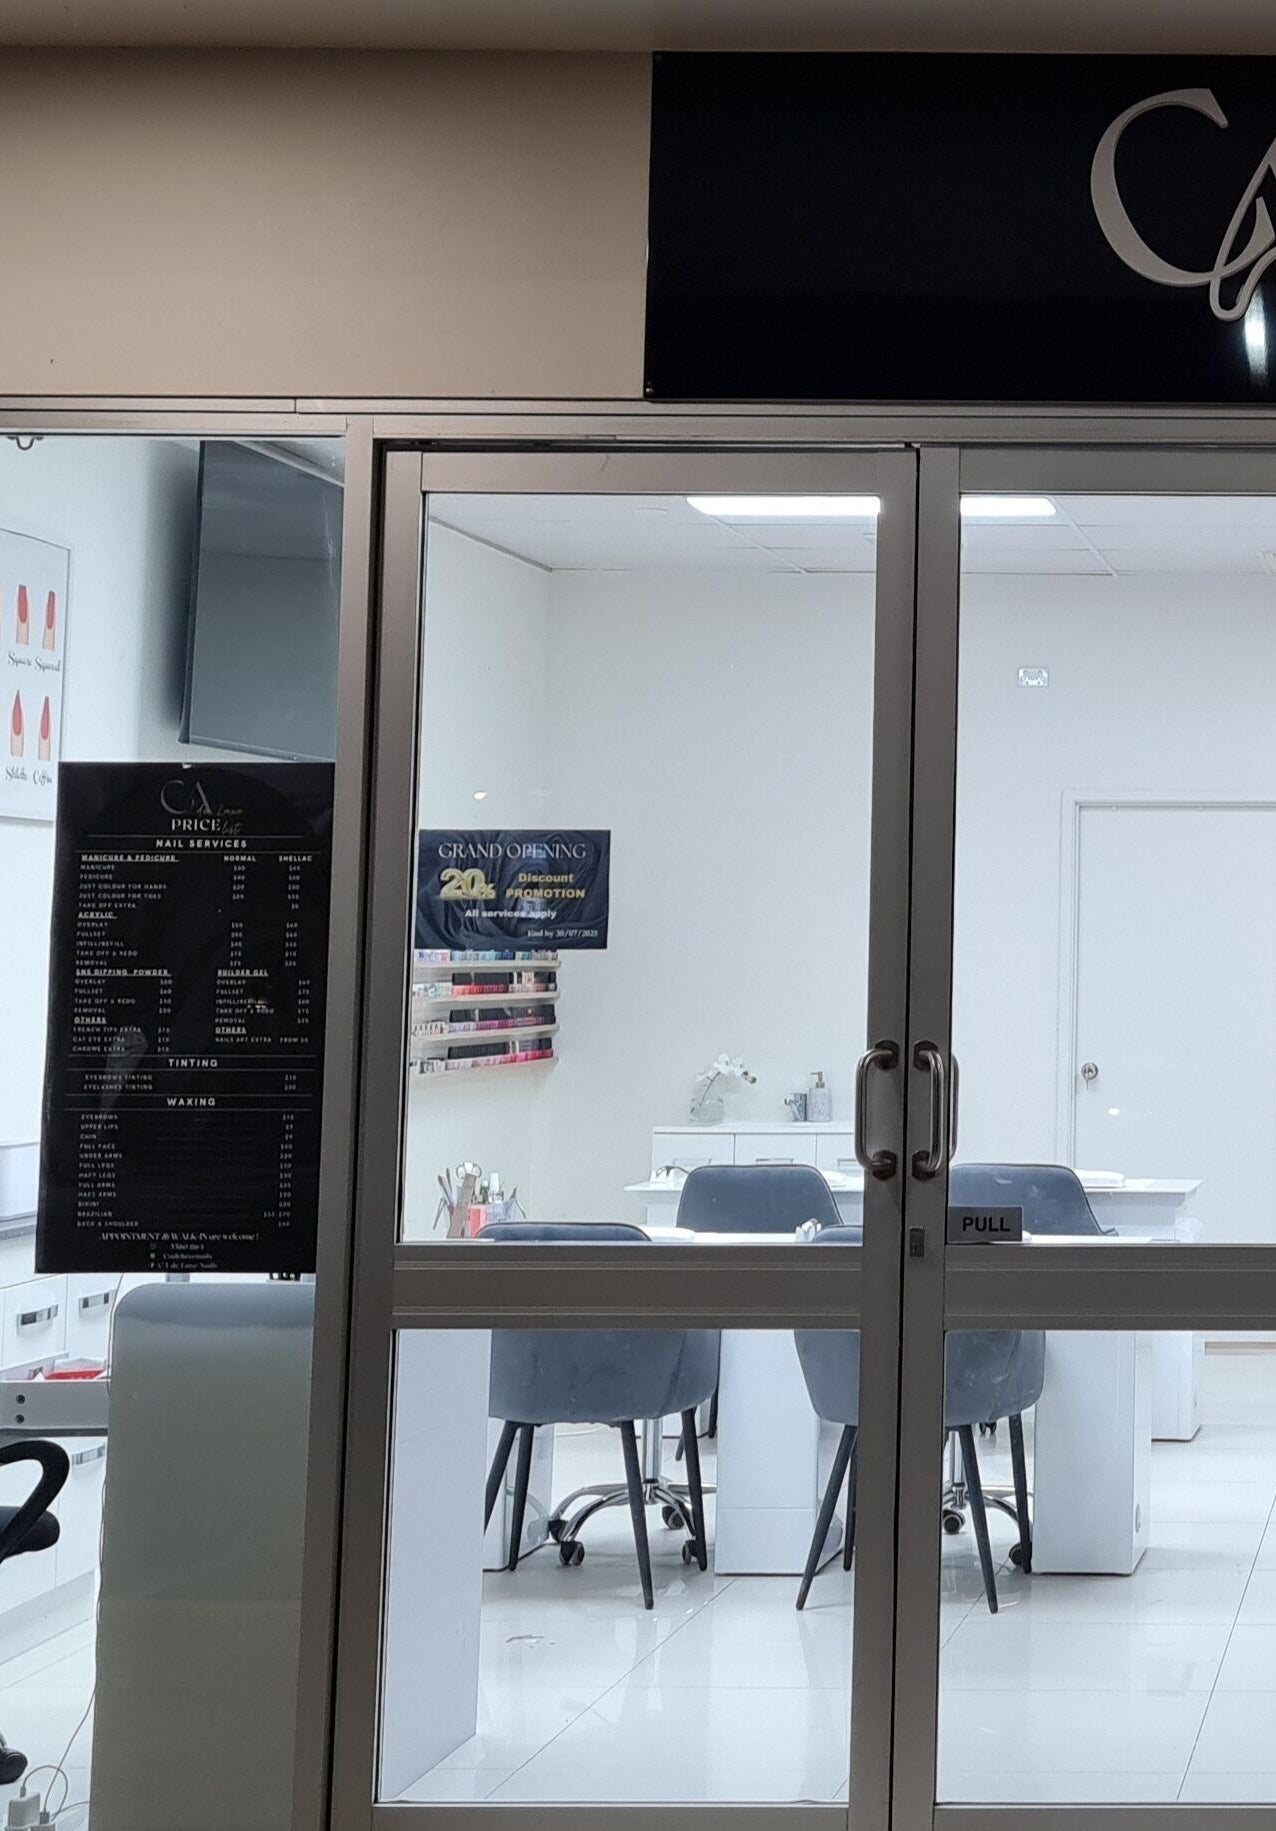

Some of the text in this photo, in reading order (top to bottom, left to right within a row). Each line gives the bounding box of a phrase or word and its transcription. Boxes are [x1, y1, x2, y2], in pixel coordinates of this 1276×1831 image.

[171, 818, 221, 831] PRICE
[156, 839, 247, 848] NAIL SERVICES
[438, 843, 587, 858] GRAND OPENING
[518, 872, 574, 883] Discount
[440, 868, 496, 900] 20%
[505, 888, 586, 899] PROMOTION
[464, 909, 557, 920] All services apply
[168, 1058, 218, 1068] TINTING
[166, 1097, 216, 1106] WAXING
[962, 1216, 1011, 1232] PULL
